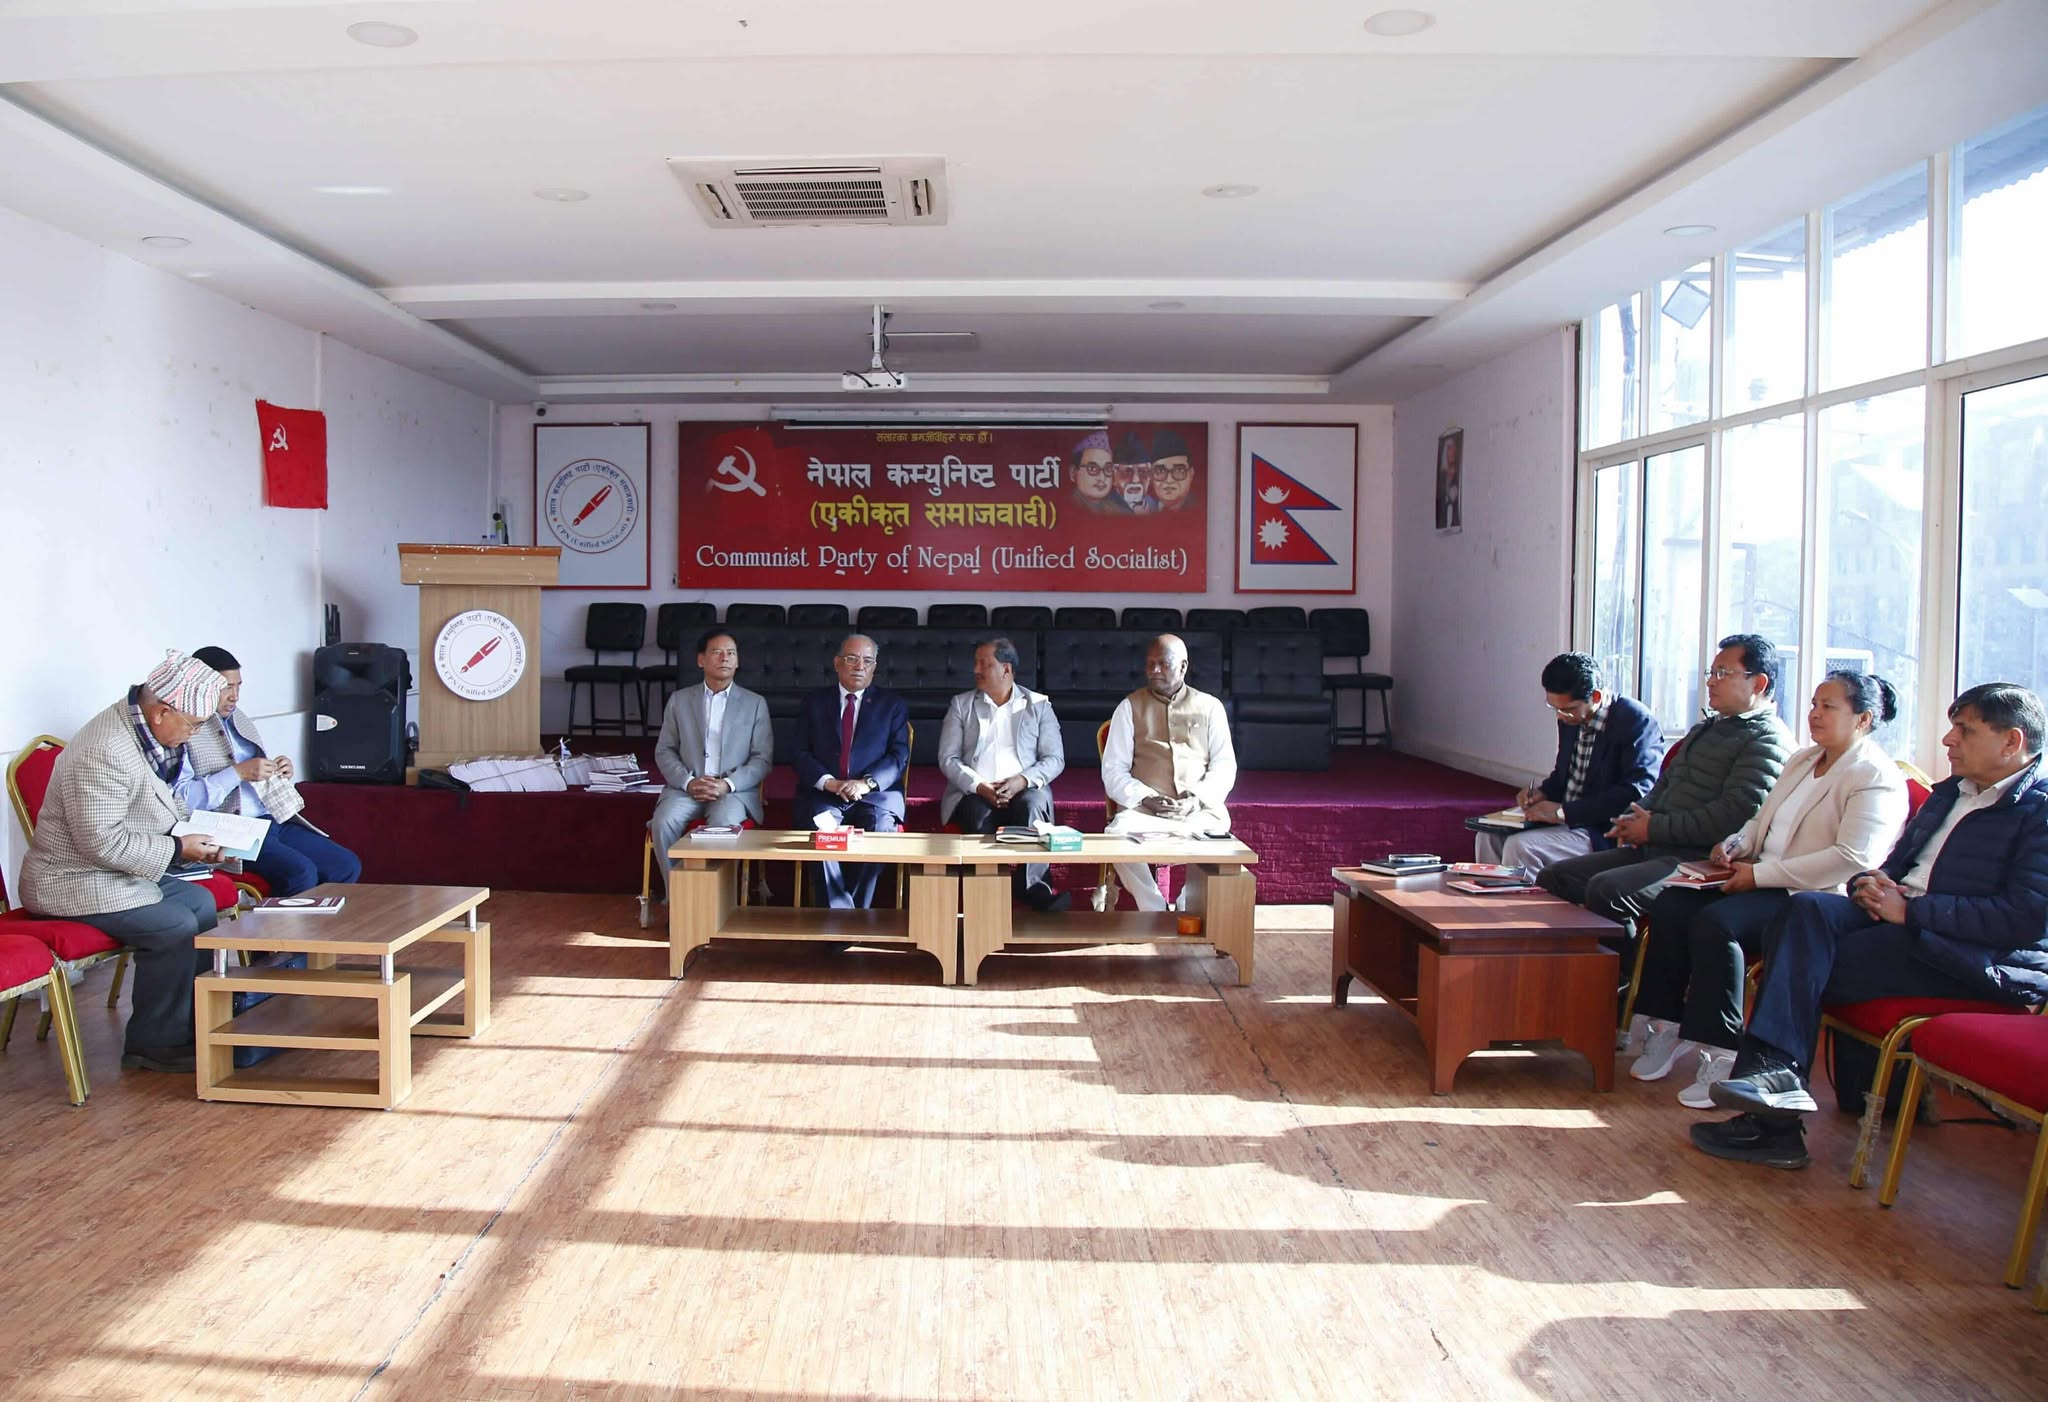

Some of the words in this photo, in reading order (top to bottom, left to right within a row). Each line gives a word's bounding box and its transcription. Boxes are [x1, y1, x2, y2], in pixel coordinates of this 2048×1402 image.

[807, 457, 871, 488] नेपाल
[886, 455, 996, 496] कम्युनिष्ट
[1008, 456, 1061, 488] पार्टी
[811, 494, 910, 535] (एकीकृत
[924, 495, 1057, 530] समाजवादी)
[696, 545, 810, 567] Communist
[818, 546, 878, 575] Party
[887, 544, 912, 568] of
[917, 545, 981, 575] Nepal
[992, 545, 1076, 575] (Unified
[1084, 546, 1188, 575] Socialist)
[445, 671, 457, 686] CPN
[818, 834, 847, 843] PREMIUM
